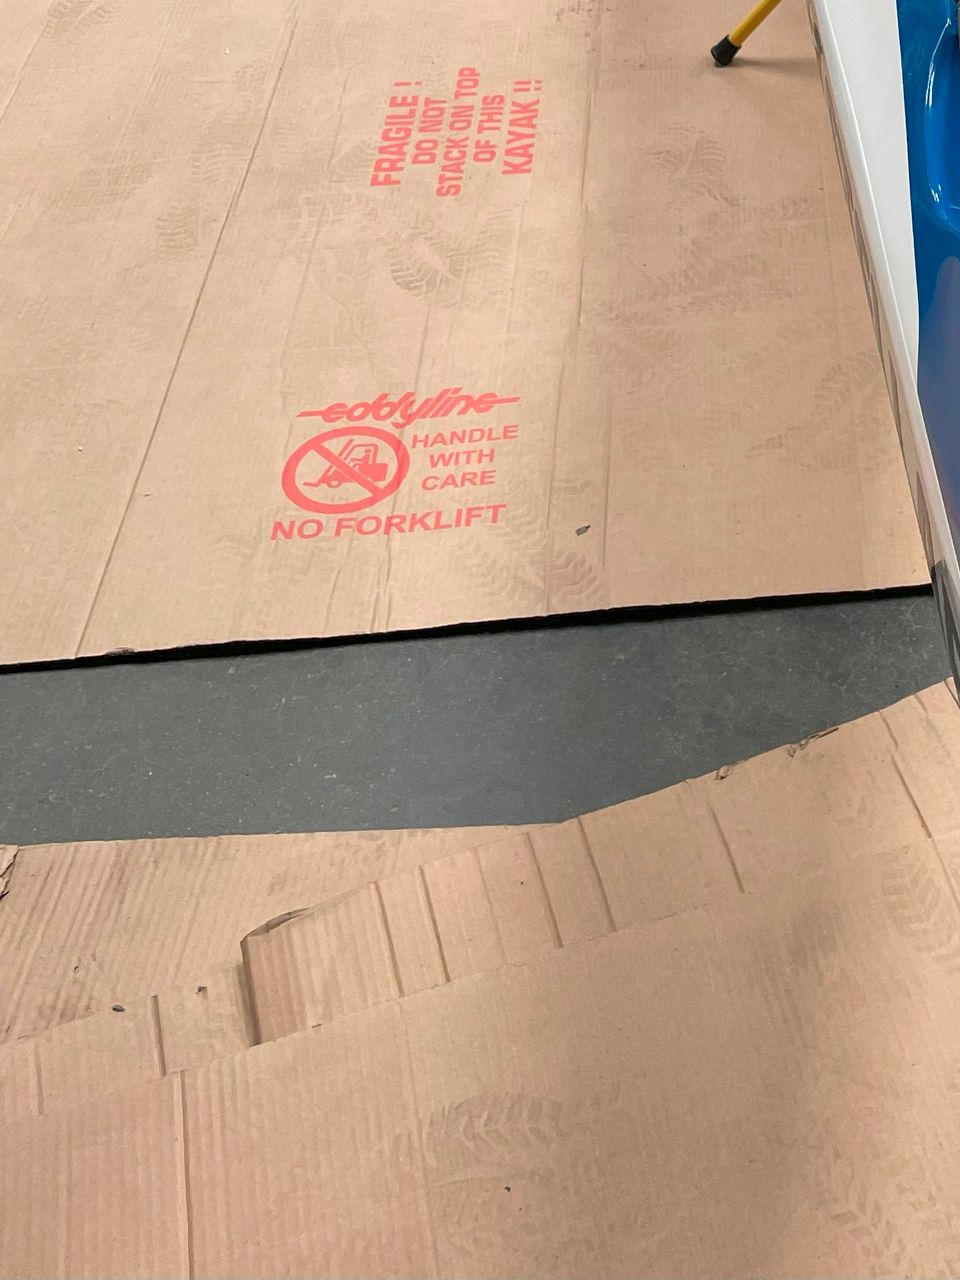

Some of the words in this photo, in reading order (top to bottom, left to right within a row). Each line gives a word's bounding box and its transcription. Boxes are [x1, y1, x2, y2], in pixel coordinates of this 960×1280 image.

[454, 67, 481, 100] TOP
[418, 97, 447, 134] NOT
[449, 105, 475, 131] ON
[477, 94, 506, 135] THIS
[369, 95, 420, 187] FRAGILE
[411, 138, 440, 165] DO
[472, 140, 498, 163] OF
[501, 99, 541, 175] KAYAK
[435, 136, 470, 197] STACK
[296, 387, 521, 430] eddyline
[411, 424, 520, 449] HANDLE
[429, 448, 496, 469] WITH
[421, 470, 497, 491] CARE
[270, 519, 324, 541] NO
[333, 504, 508, 538] FORKLIFT
